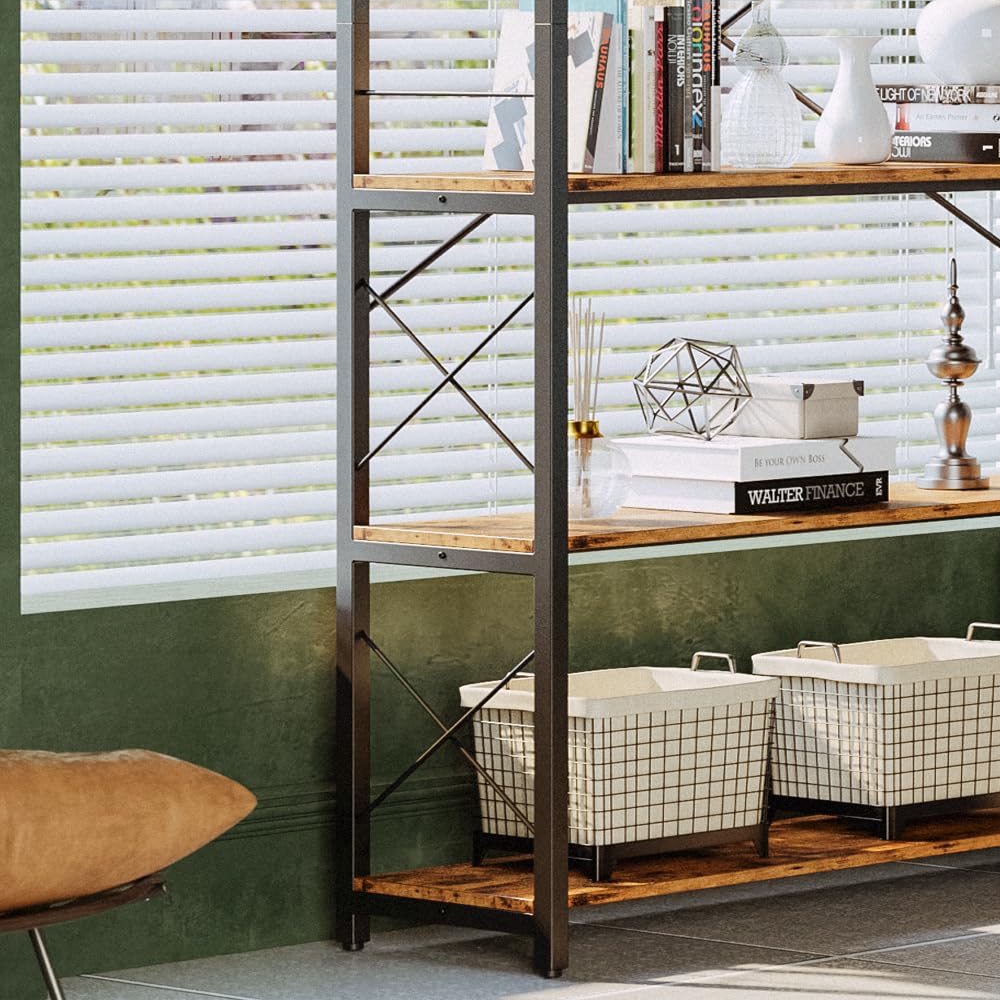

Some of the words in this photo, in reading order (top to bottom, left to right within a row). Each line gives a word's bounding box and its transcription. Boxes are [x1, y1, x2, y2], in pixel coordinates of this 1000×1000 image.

[703, 2, 711, 72] BAUHAUS
[595, 27, 611, 89] BAUHAUS
[676, 34, 685, 87] INTERIORS
[881, 88, 906, 100] LIGHT
[908, 88, 920, 100] OF
[922, 88, 942, 102] NEW
[942, 88, 972, 102] YORK
[754, 458, 763, 468] BE
[764, 457, 785, 467] YOUR
[785, 456, 806, 465] OWN
[809, 454, 825, 464] BOSS
[748, 486, 804, 505] WALTER
[804, 482, 864, 501] FINANCE
